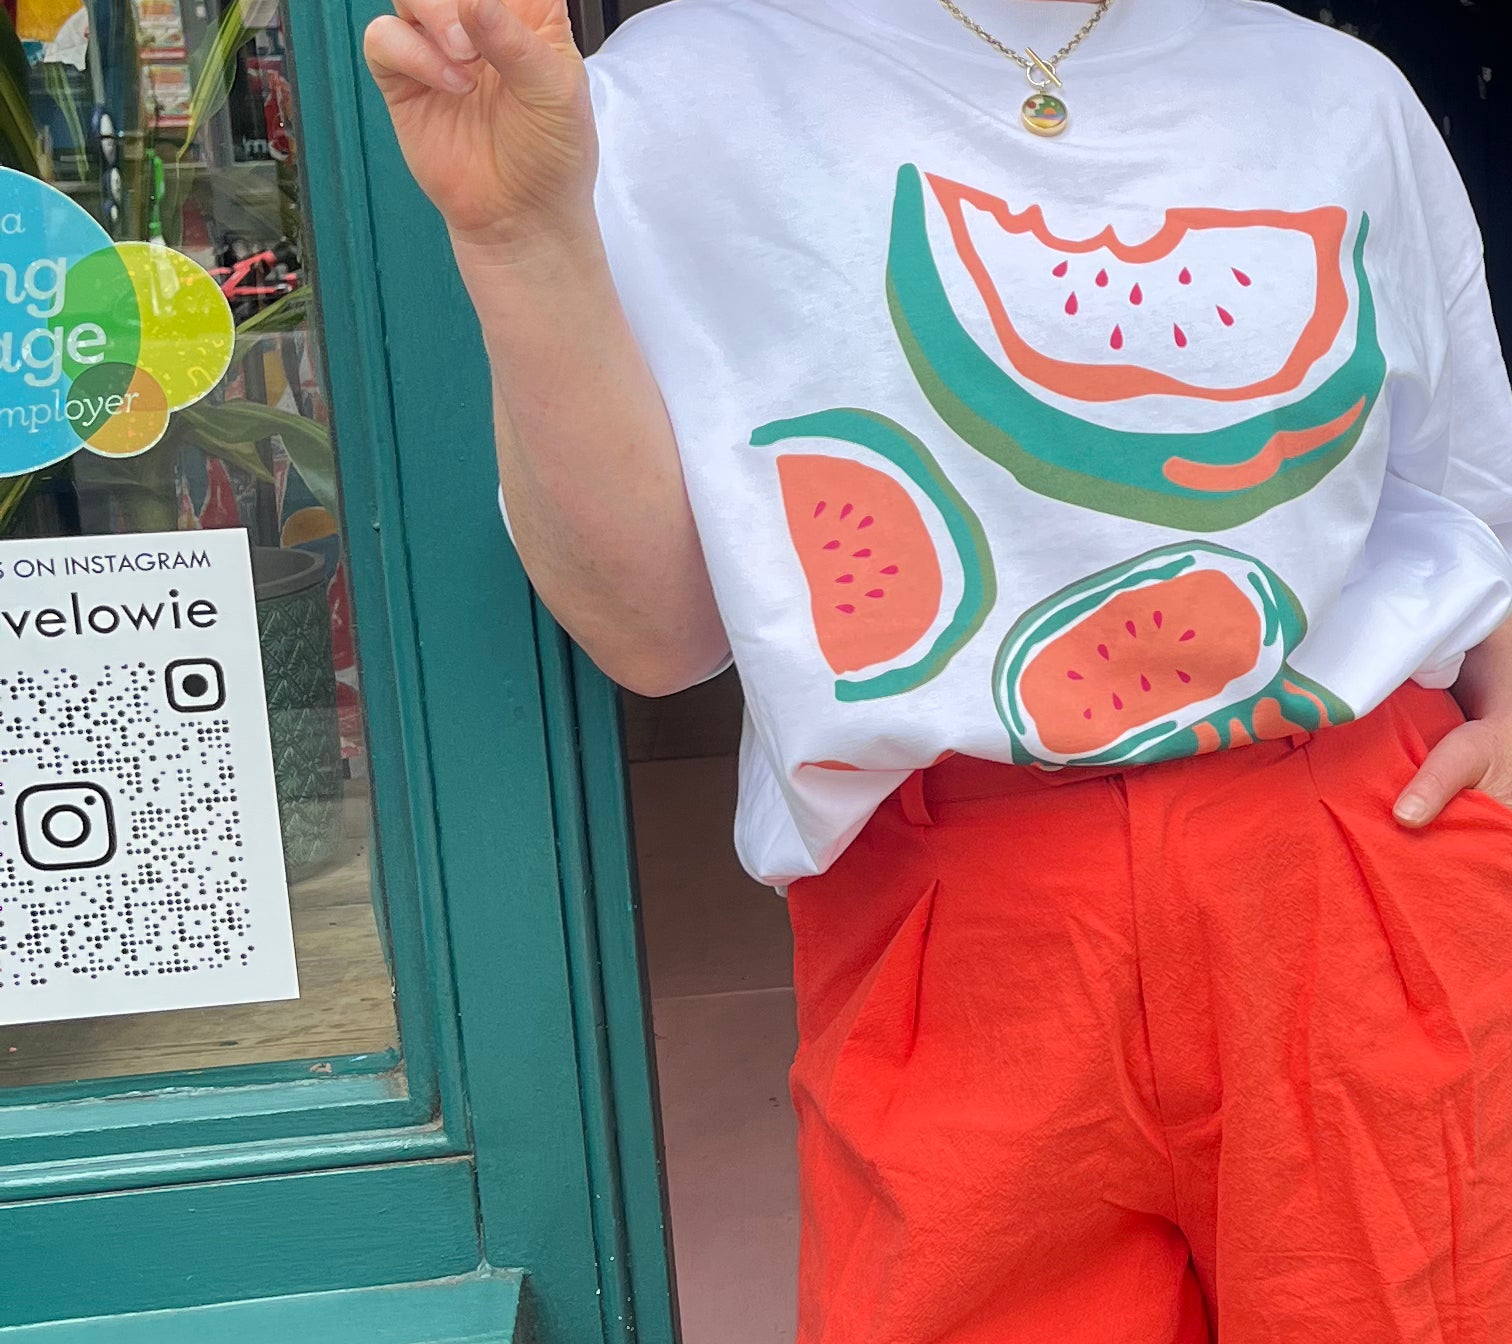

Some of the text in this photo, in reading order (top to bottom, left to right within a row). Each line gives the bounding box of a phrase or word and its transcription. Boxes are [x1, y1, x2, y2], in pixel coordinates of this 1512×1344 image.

[13, 558, 56, 578] ON
[65, 549, 211, 576] INSTAGRAM
[2, 588, 218, 639] velowie
